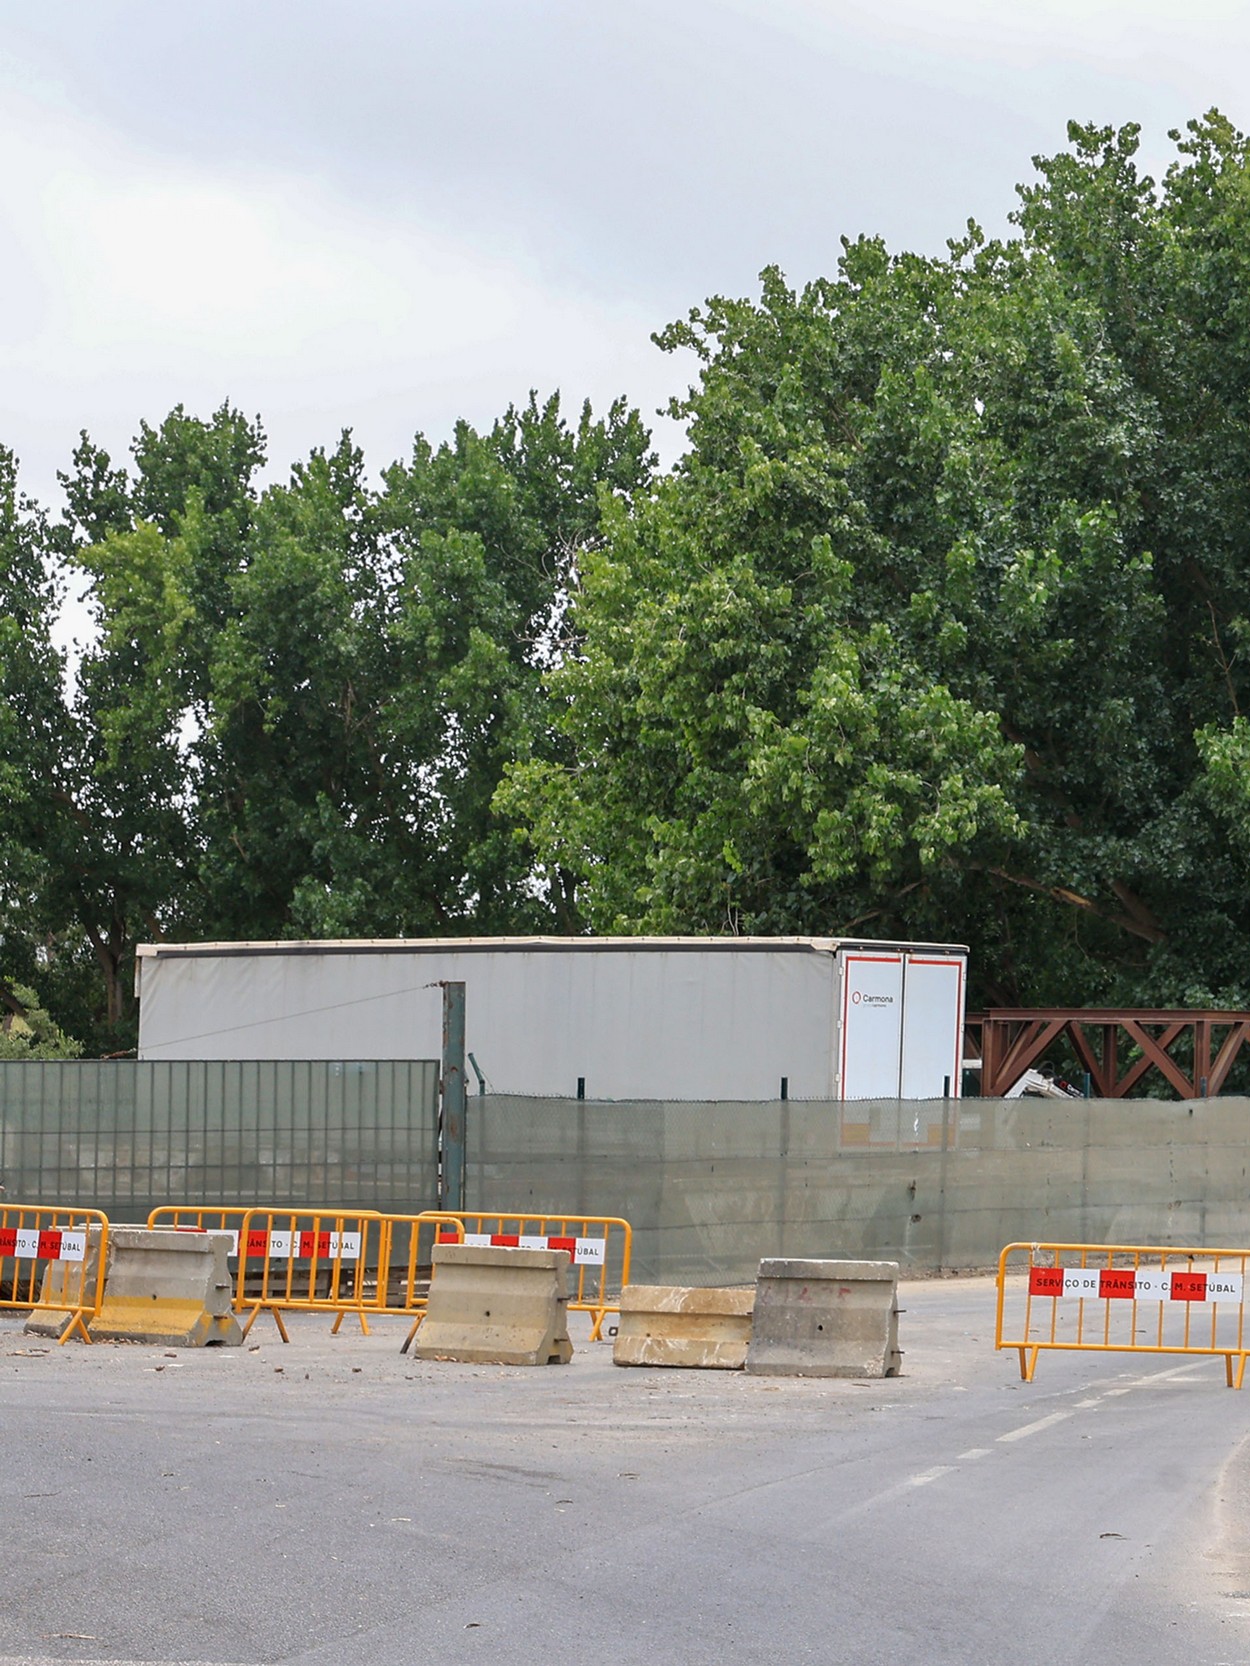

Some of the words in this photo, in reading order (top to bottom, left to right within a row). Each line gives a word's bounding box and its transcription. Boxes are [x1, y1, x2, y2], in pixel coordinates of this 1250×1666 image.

[863, 994, 893, 1003] Carmona
[0, 1237, 26, 1248] RÂNSITO
[1036, 1278, 1079, 1290] SERVIÇO
[1083, 1279, 1096, 1289] DE
[1100, 1279, 1151, 1291] TRÂNSITO
[1189, 1282, 1236, 1293] SETÚBAL
